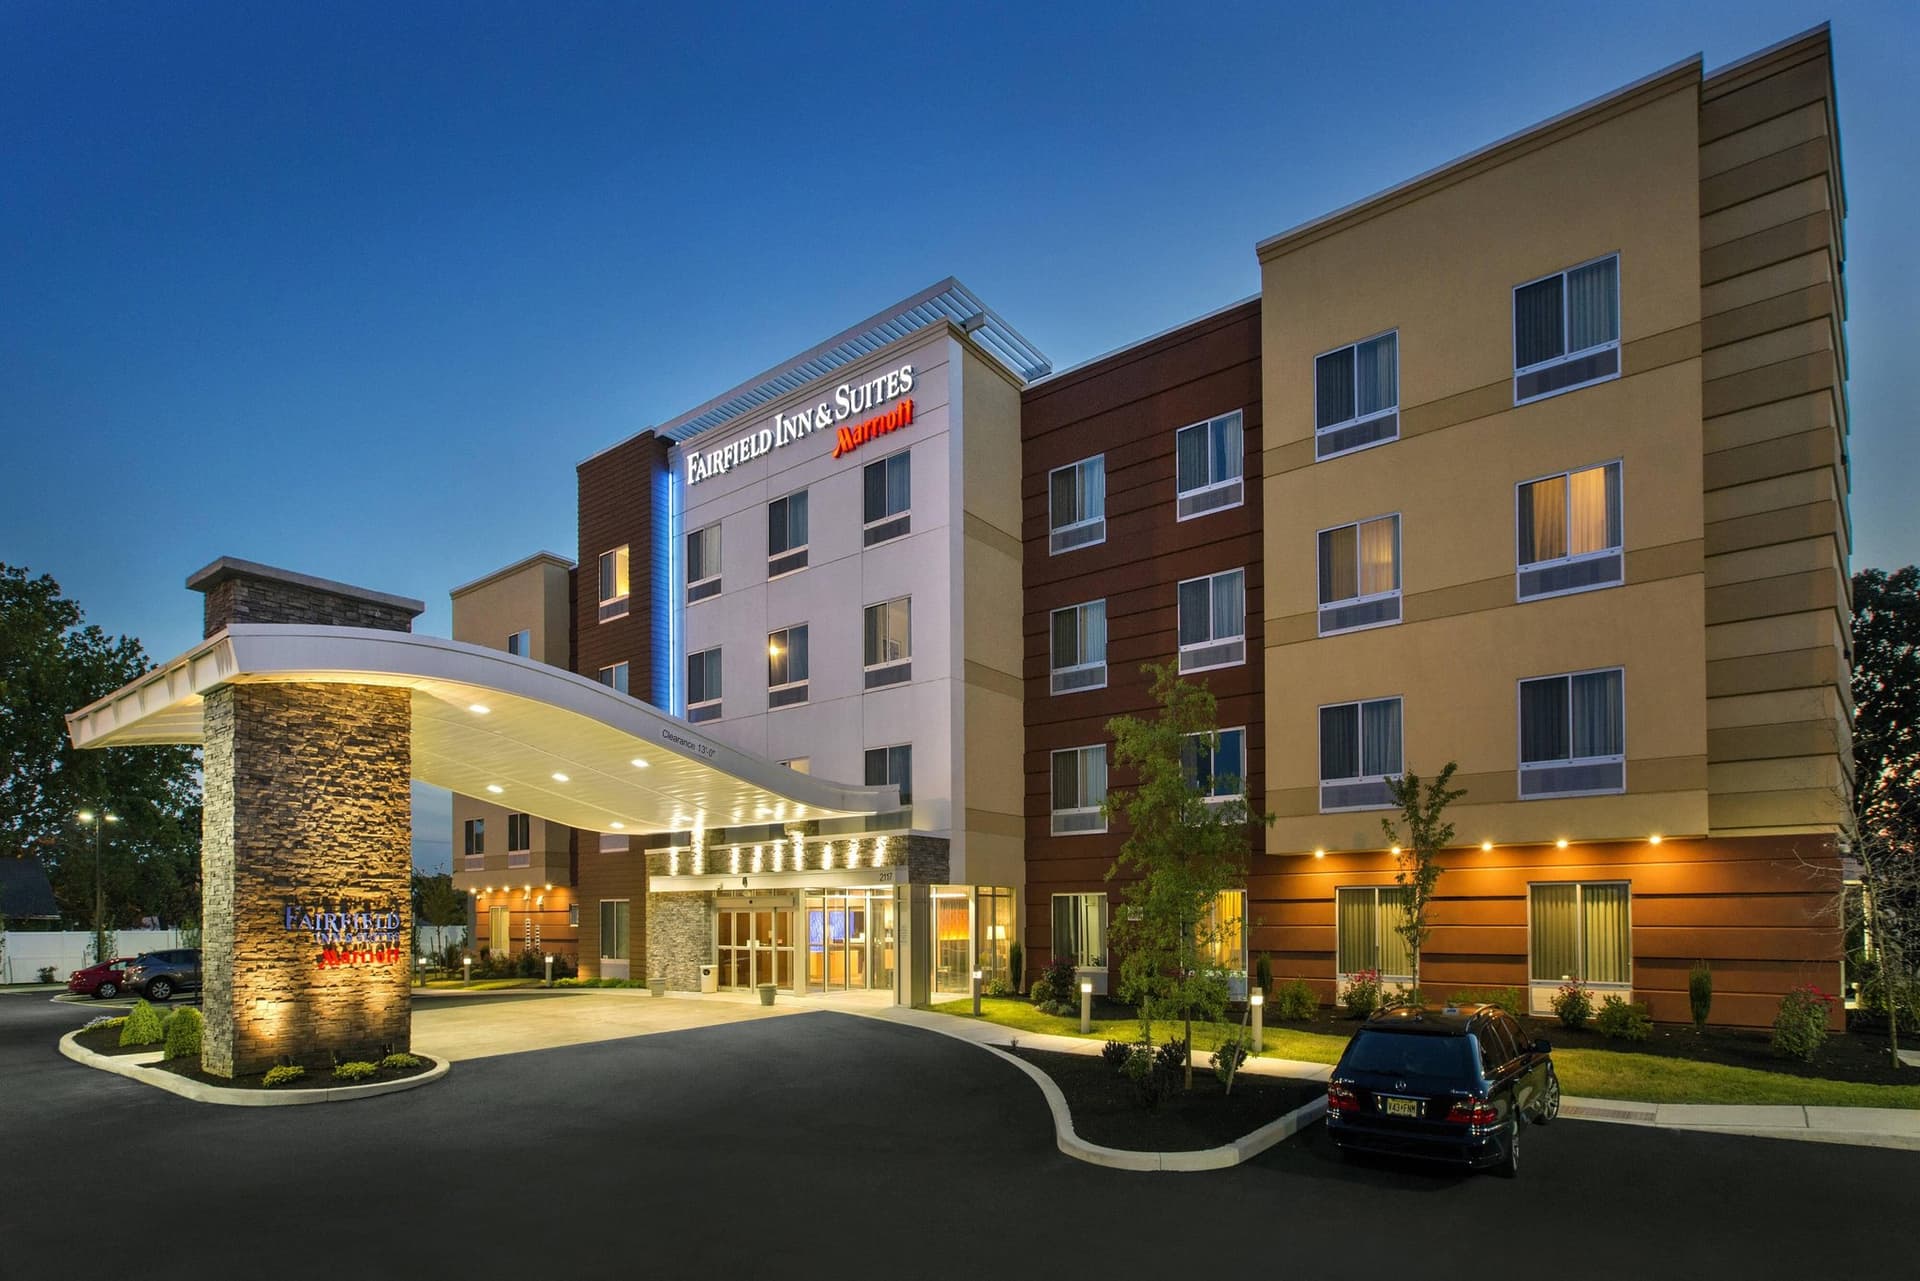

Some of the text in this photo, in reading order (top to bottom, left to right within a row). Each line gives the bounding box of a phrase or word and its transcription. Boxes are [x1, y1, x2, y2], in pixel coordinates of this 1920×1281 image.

[686, 365, 914, 485] FAIRFIELD INN & SUITES
[832, 398, 914, 459] Marriott
[662, 729, 696, 750] Clearance
[285, 905, 400, 932] FAIRFIELD
[317, 948, 400, 970] Marriott
